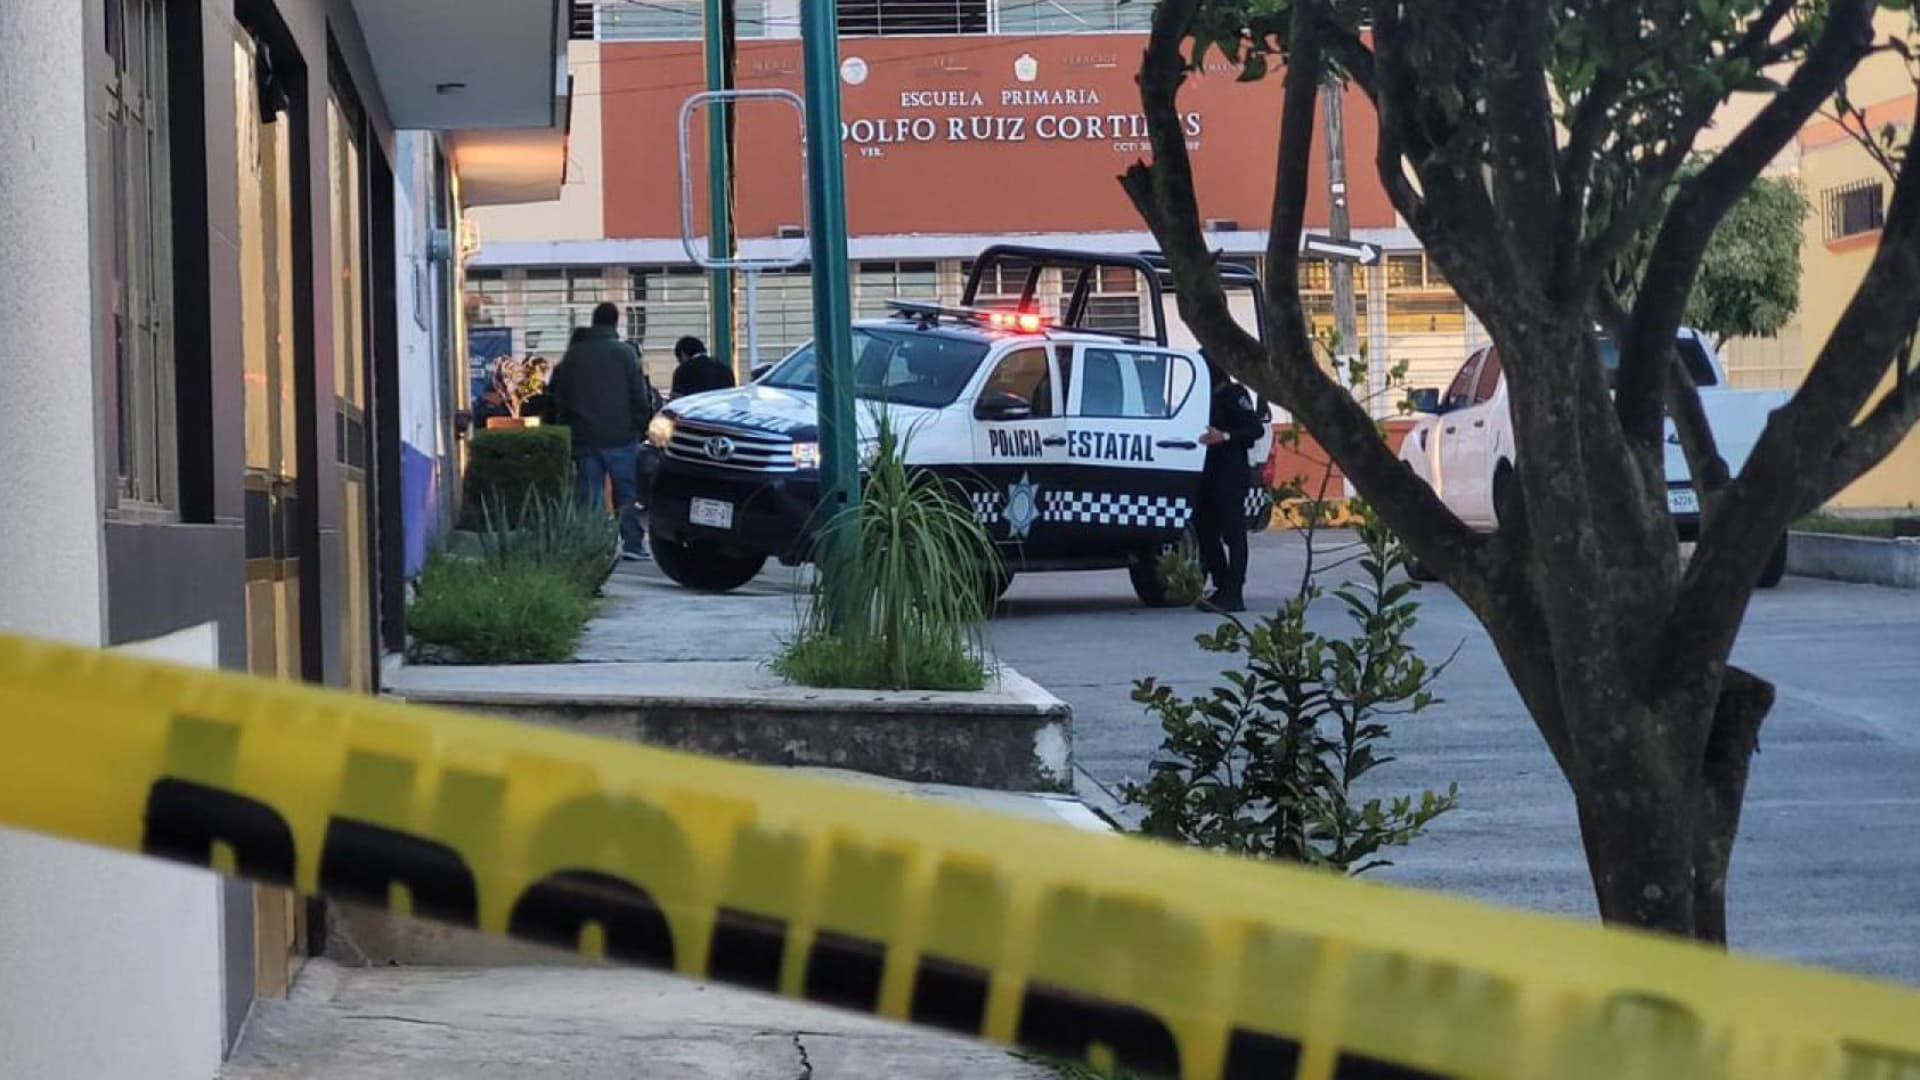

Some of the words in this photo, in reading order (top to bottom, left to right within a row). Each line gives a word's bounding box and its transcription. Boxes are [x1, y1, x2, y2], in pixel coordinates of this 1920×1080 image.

[901, 90, 983, 107] ESCUELA
[1001, 88, 1100, 106] PRIMARIA
[802, 117, 936, 143] OLFO
[946, 115, 1026, 141] RUIZ
[1035, 112, 1201, 141] CORTIS
[1066, 430, 1155, 462] ESTATAL
